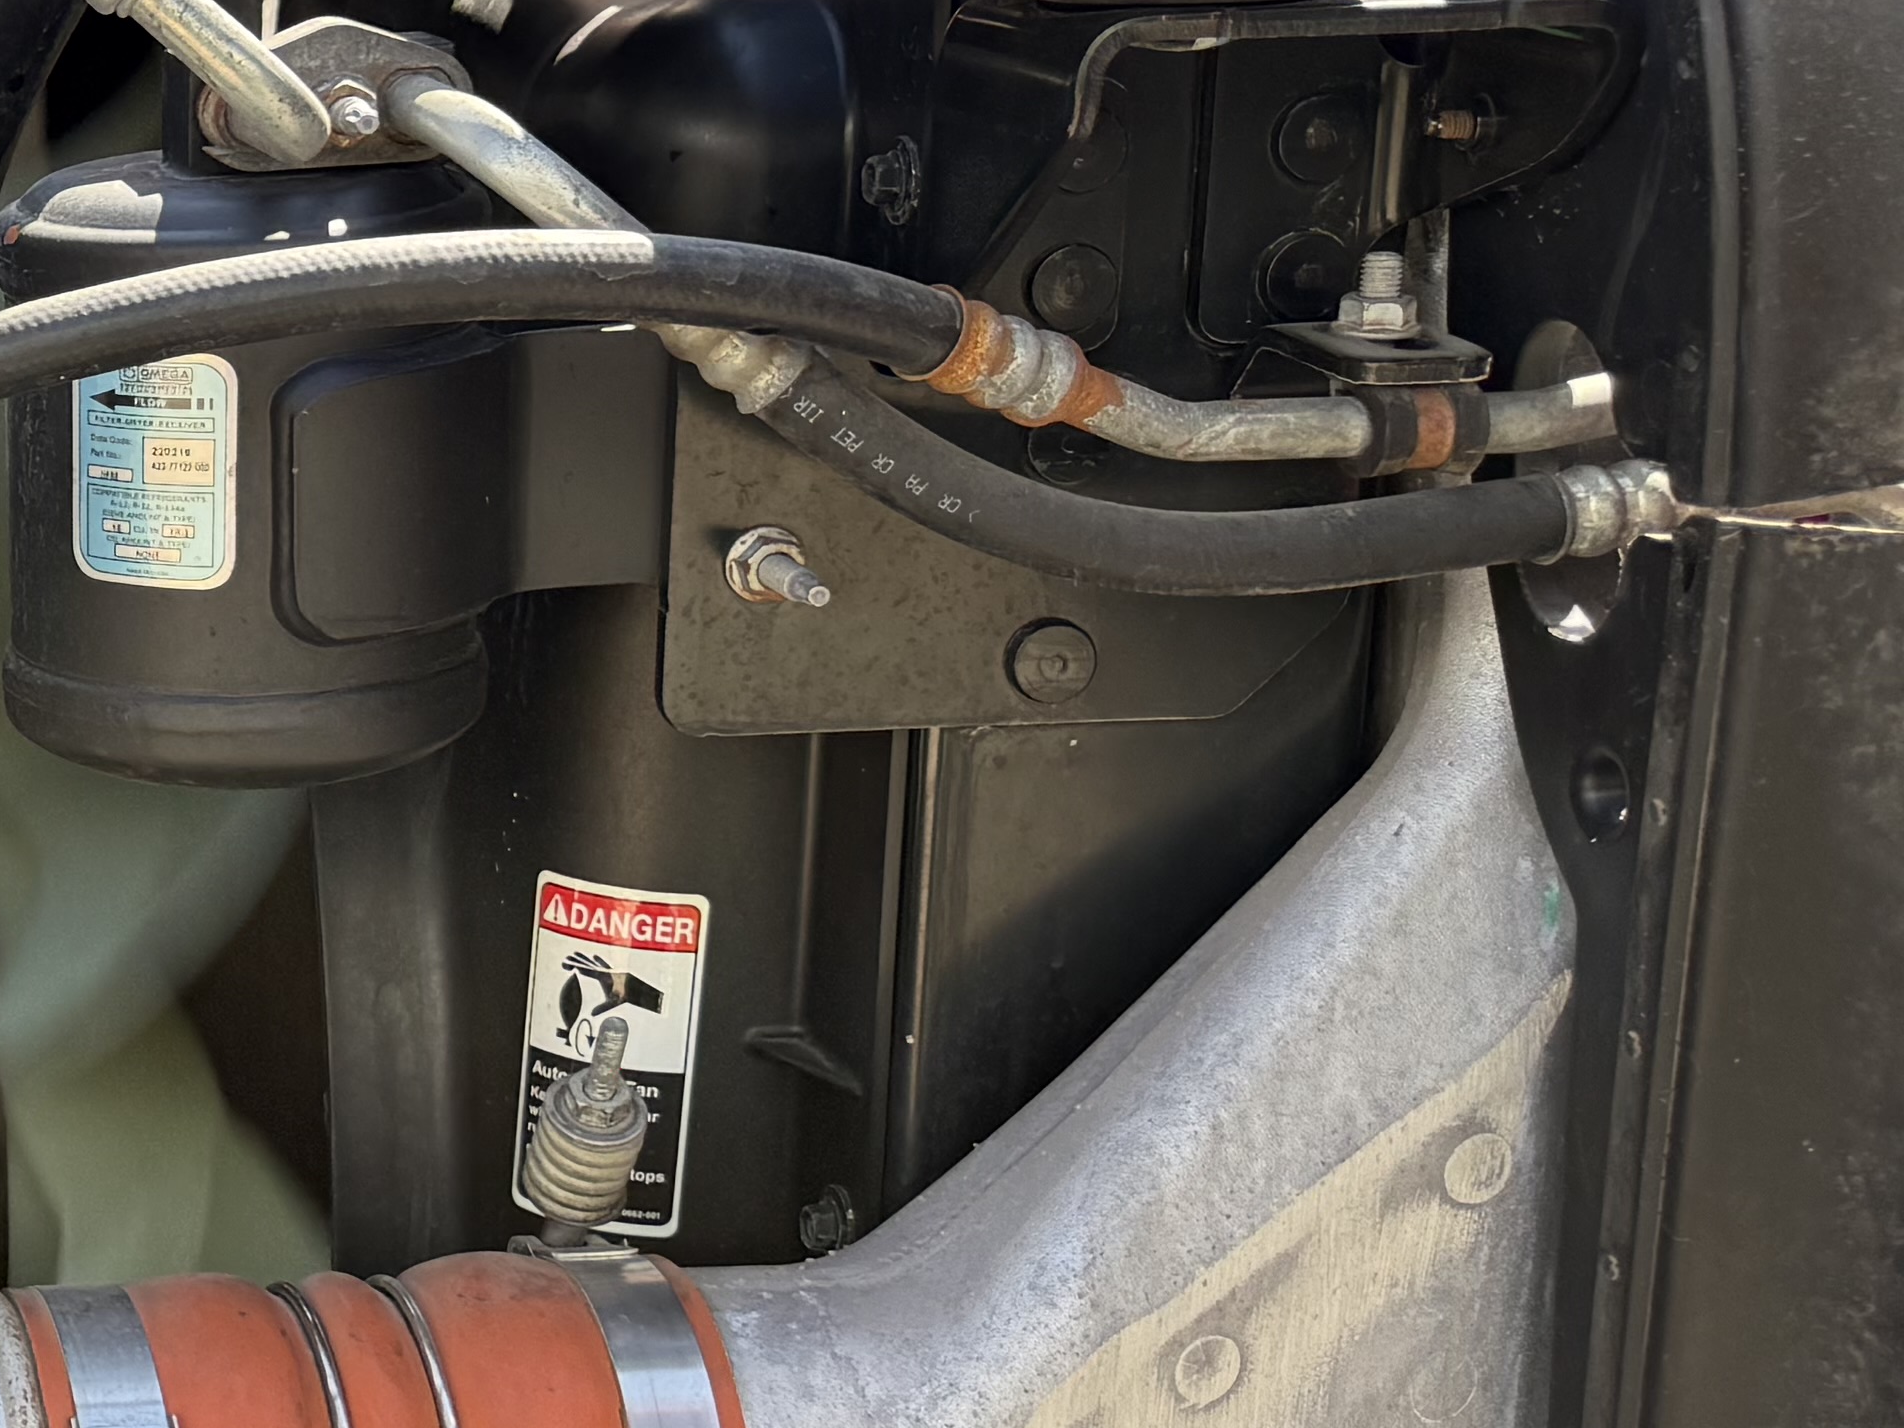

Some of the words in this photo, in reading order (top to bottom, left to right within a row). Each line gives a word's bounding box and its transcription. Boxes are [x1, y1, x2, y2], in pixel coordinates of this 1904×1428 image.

[141, 368, 190, 379] OMEGA
[830, 427, 864, 453] PET
[871, 453, 895, 474] CR
[905, 474, 929, 496] PA
[937, 493, 962, 513] CR
[569, 902, 695, 945] DANGER
[630, 1169, 665, 1184] tops
